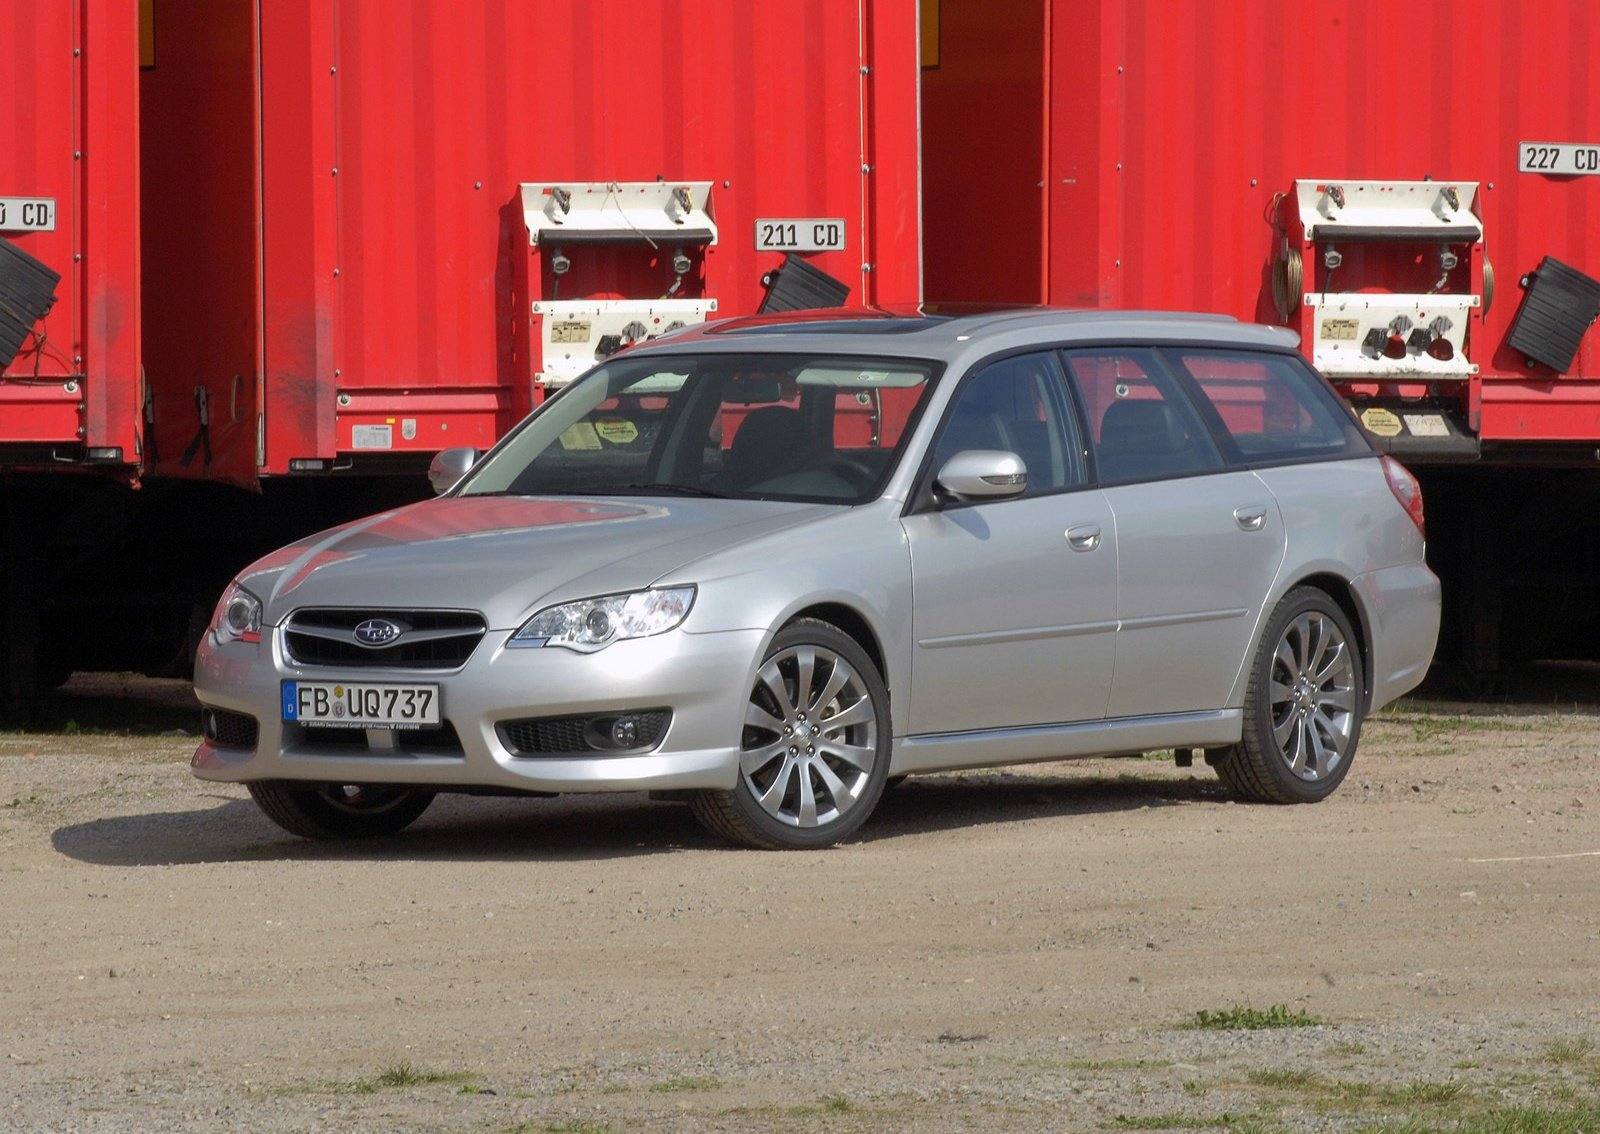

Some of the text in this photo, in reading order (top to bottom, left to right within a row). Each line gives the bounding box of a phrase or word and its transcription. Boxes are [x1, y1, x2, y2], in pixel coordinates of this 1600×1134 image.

[1526, 147, 1598, 170] 227 CD
[22, 203, 48, 226] CD
[763, 224, 839, 246] 211 CD
[298, 687, 330, 717] FB
